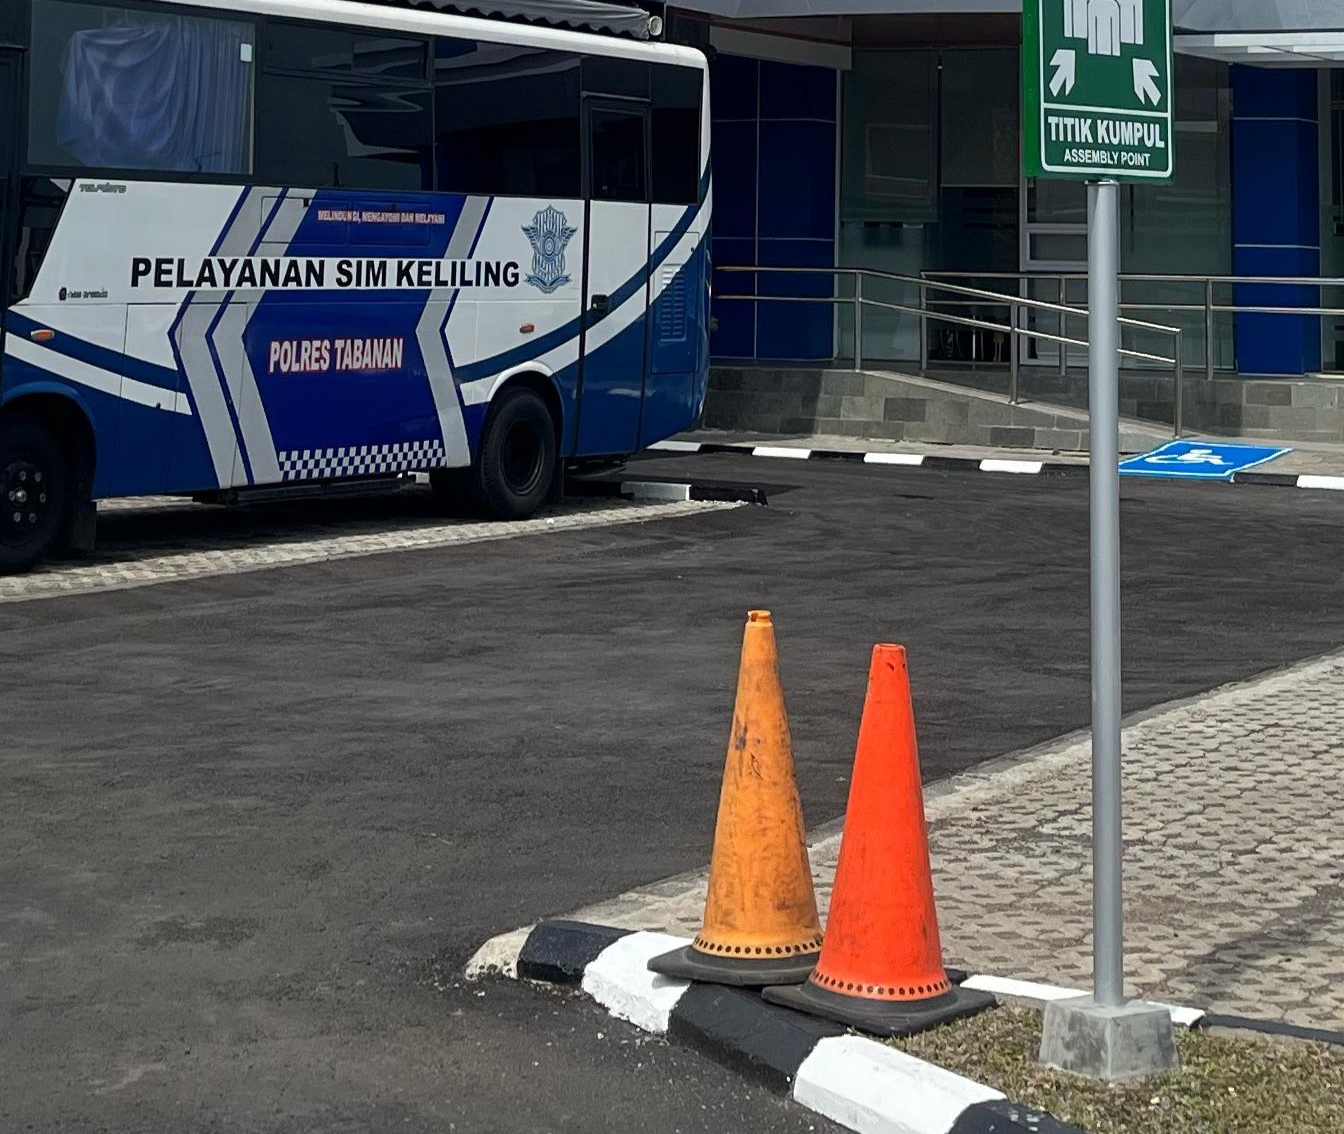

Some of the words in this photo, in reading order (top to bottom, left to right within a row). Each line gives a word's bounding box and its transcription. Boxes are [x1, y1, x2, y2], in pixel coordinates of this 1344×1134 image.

[1047, 116, 1094, 144] TITIK
[1097, 119, 1166, 148] KUMPUL
[1063, 148, 1119, 166] ASSEMBLY
[1120, 152, 1151, 167] POINT
[130, 257, 325, 288] PELAYANAN
[335, 259, 387, 288] SIM
[396, 260, 520, 288] KELILING
[268, 339, 330, 373] POLRES
[334, 337, 404, 371] TABANAN
